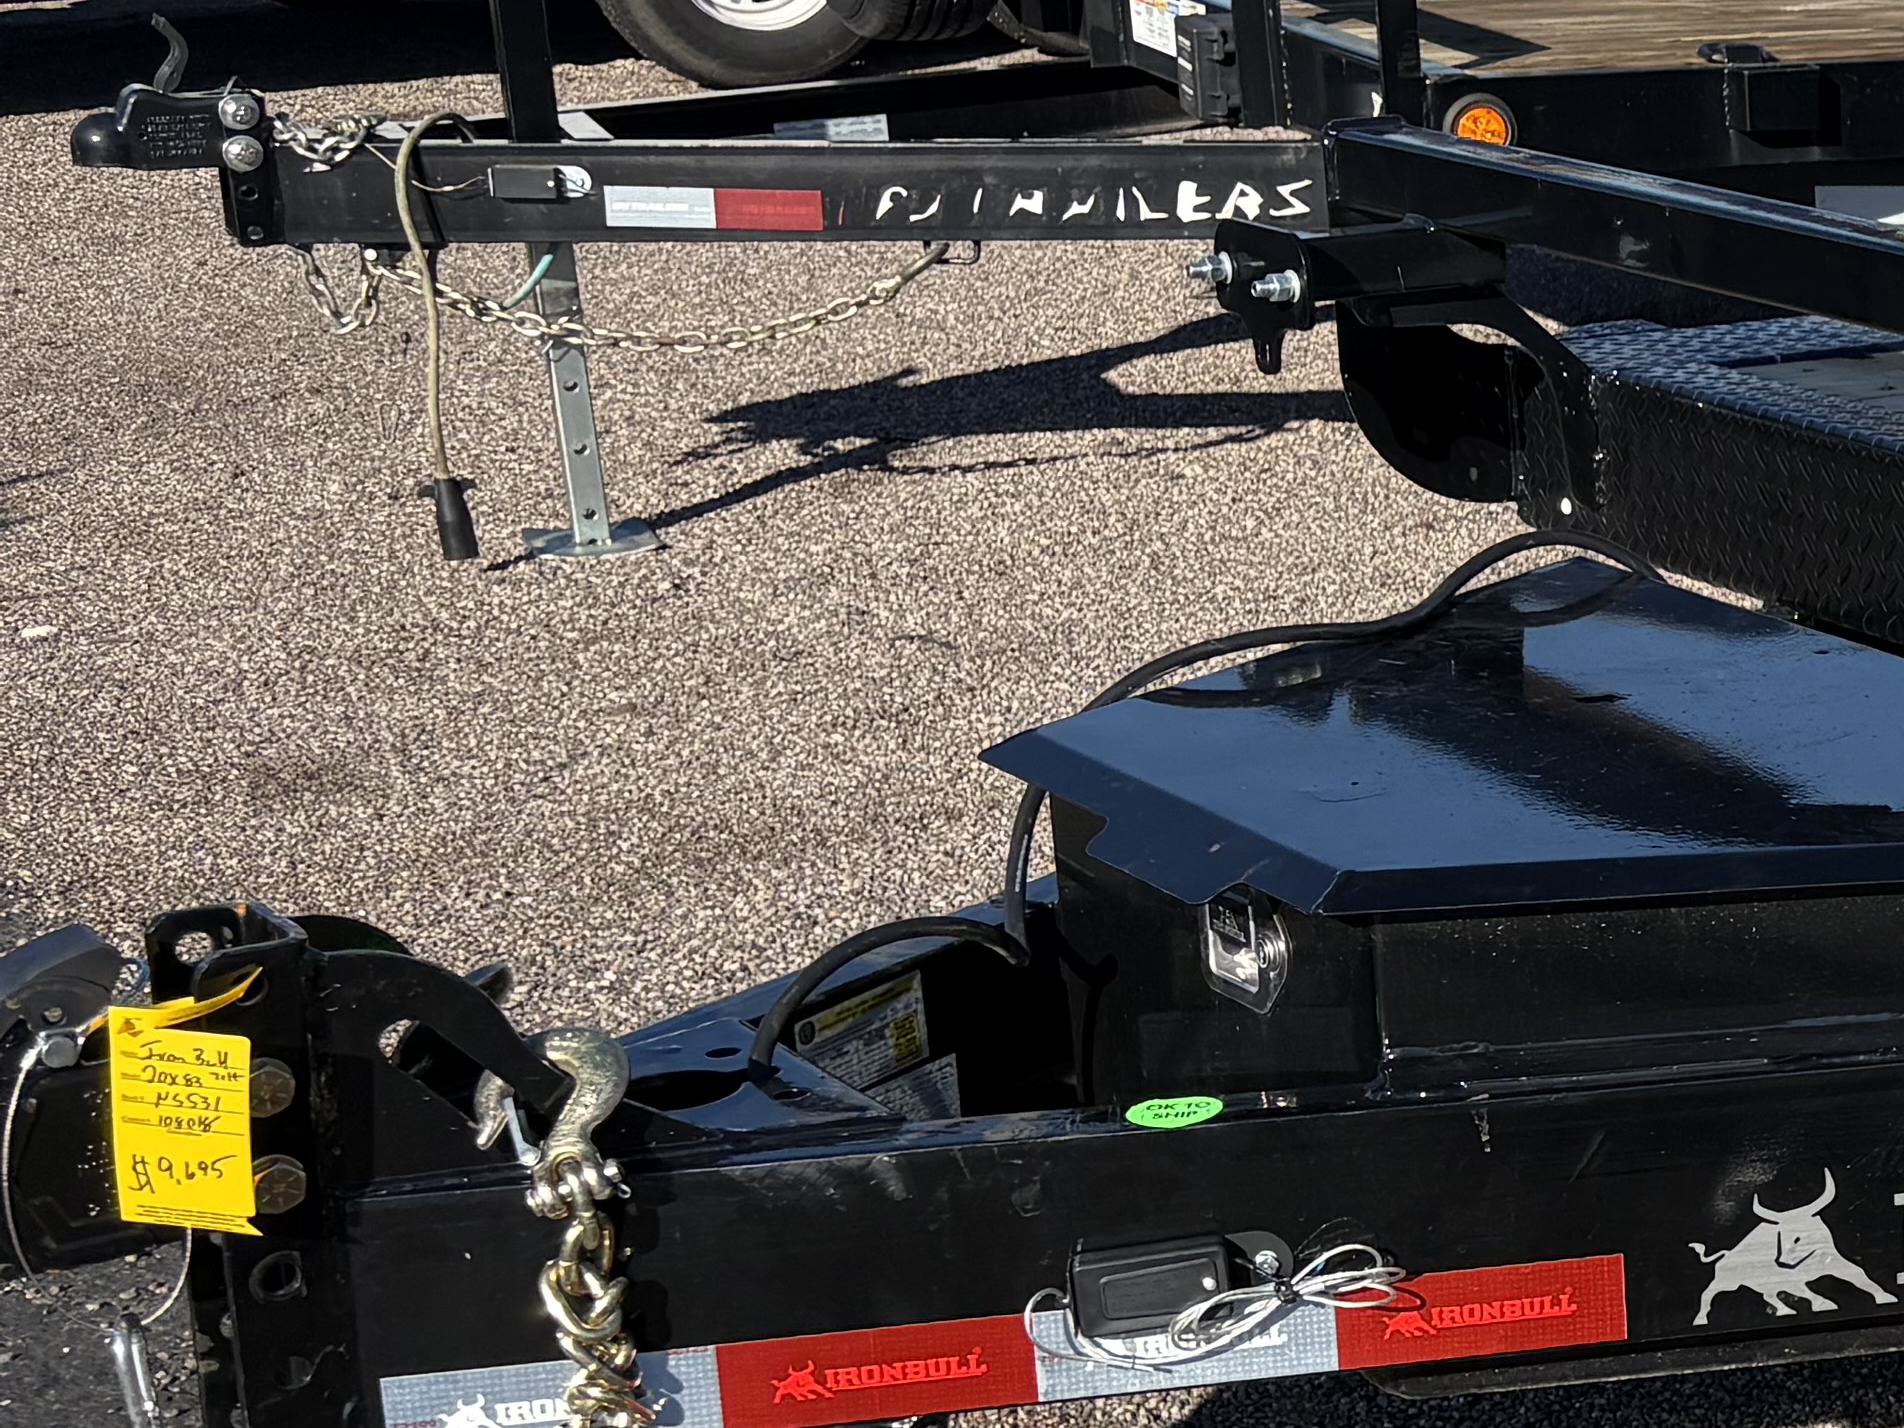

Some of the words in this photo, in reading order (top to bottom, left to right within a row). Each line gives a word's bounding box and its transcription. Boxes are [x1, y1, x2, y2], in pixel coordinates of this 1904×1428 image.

[1146, 1103, 1180, 1111] OK
[1152, 1111, 1199, 1120] SHIP
[1431, 1290, 1578, 1329] IRONBULL
[824, 1358, 988, 1392] IRONBULL
